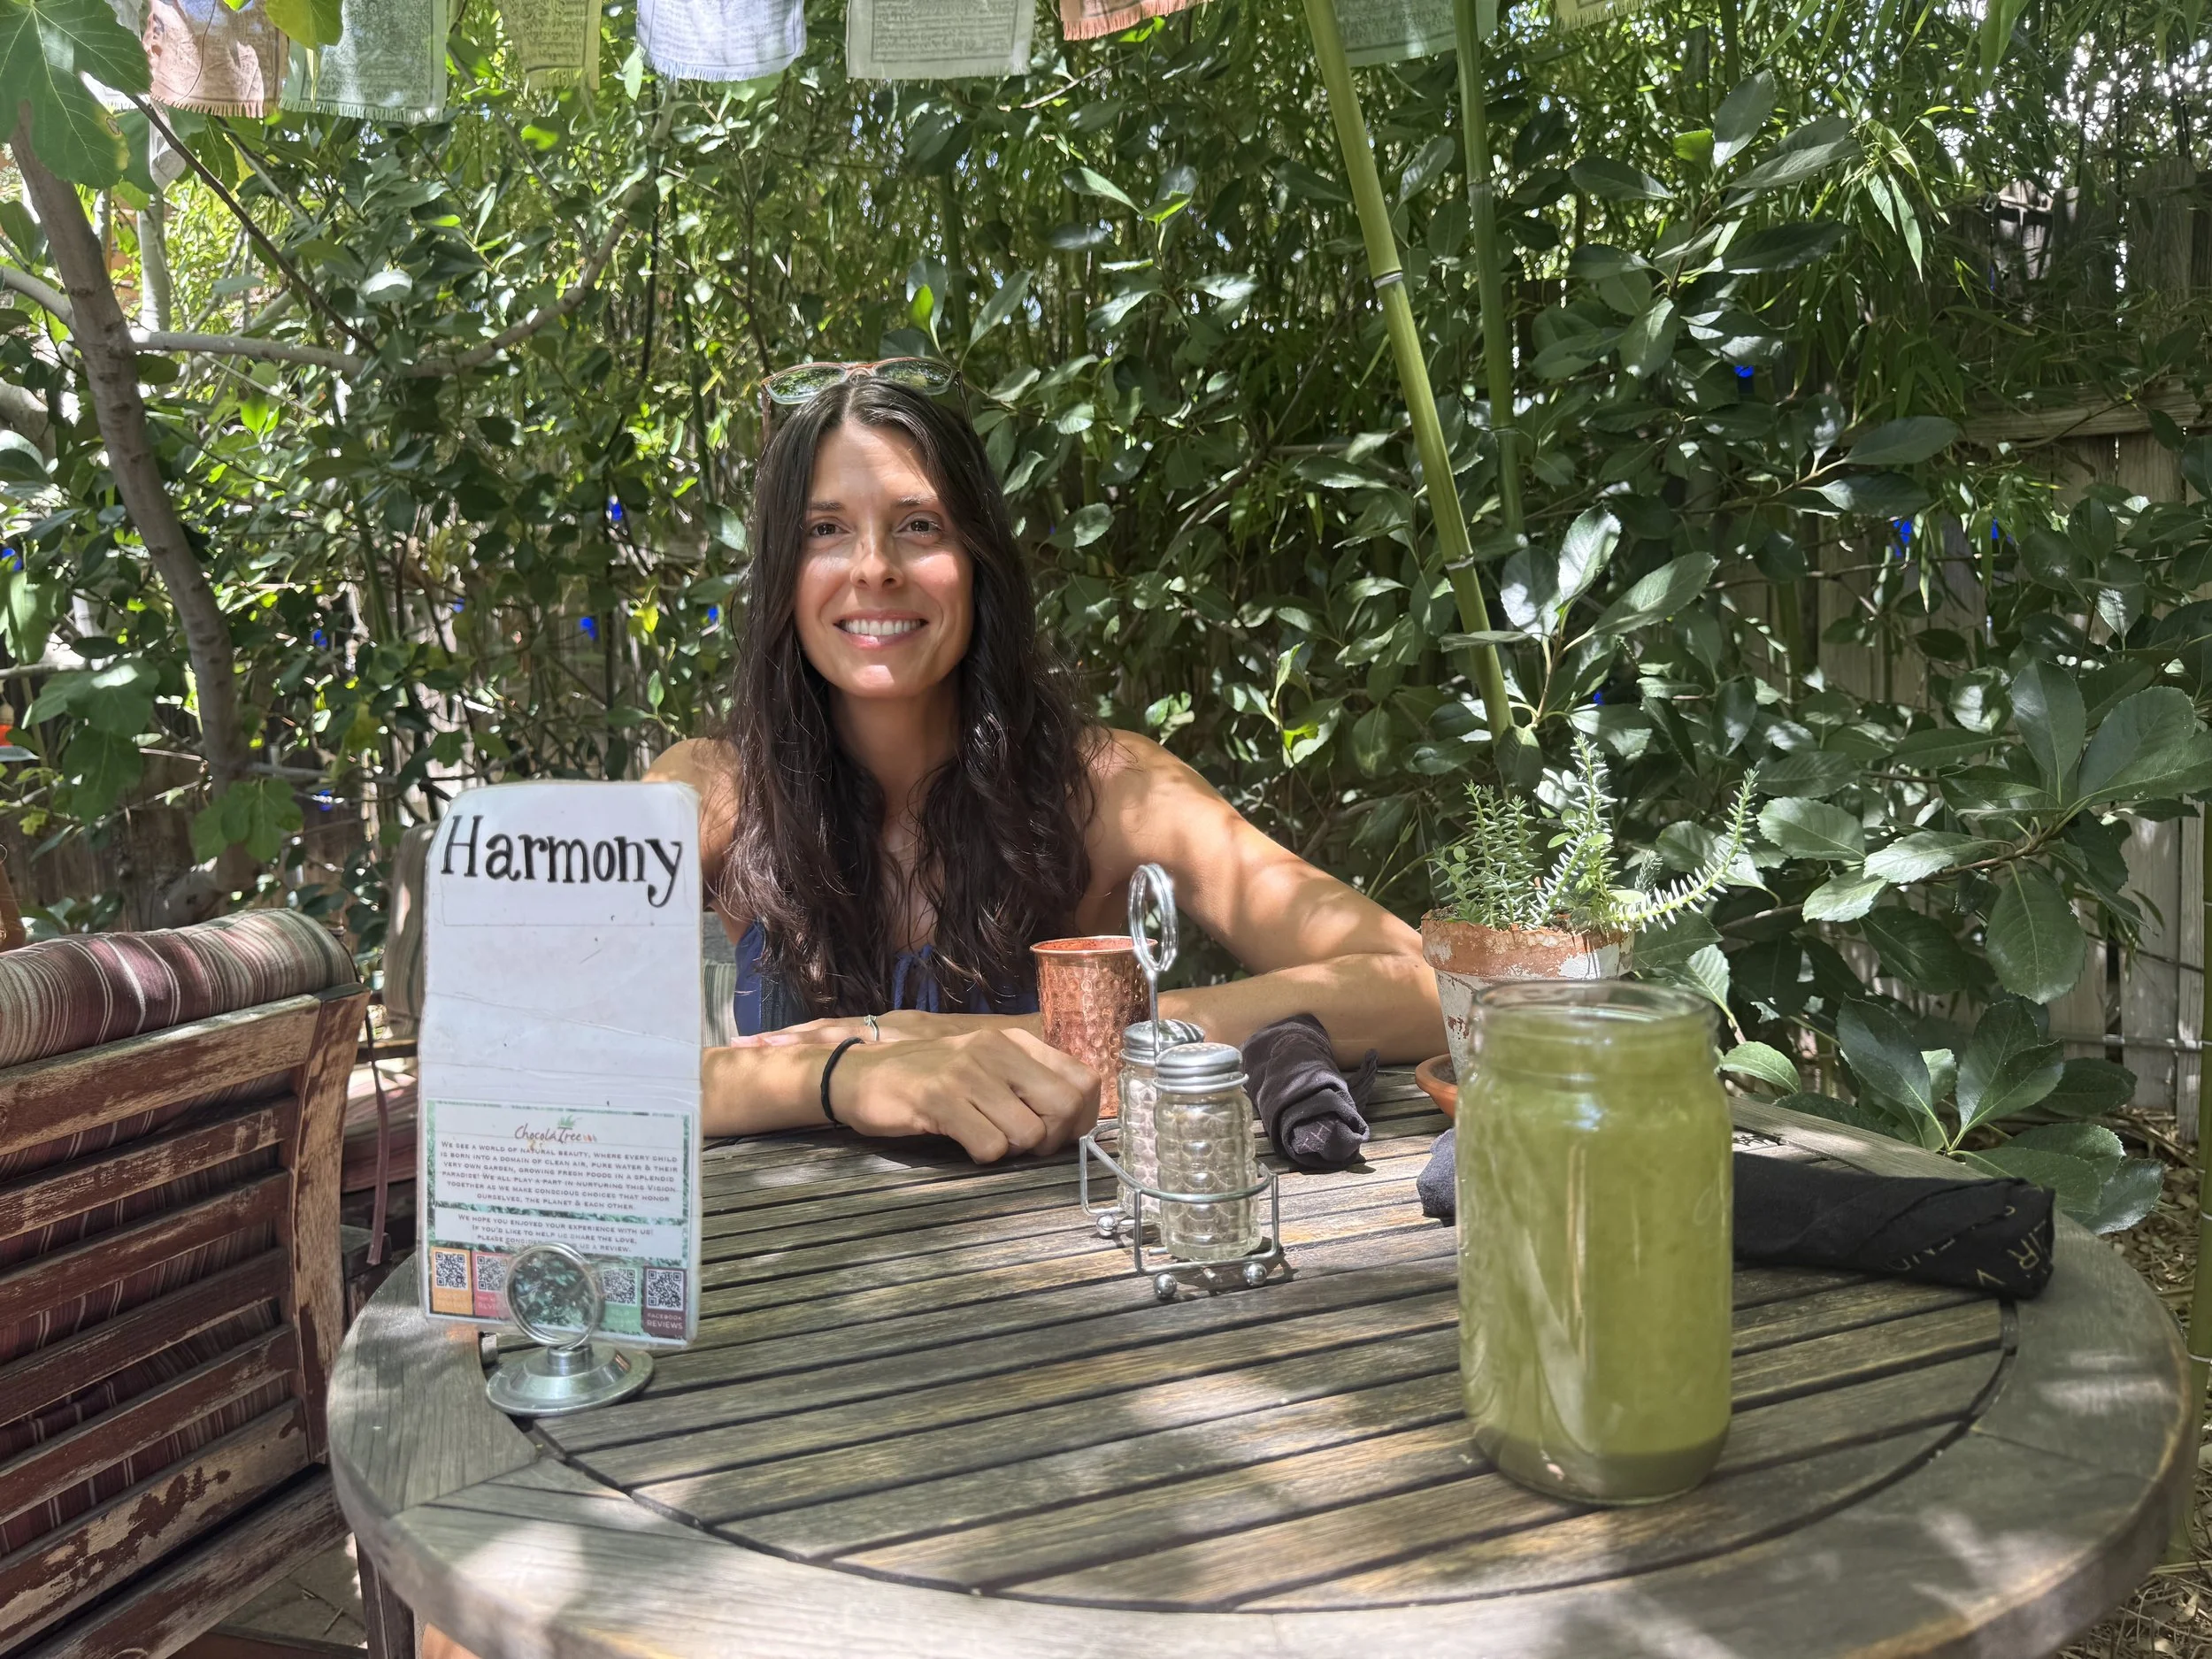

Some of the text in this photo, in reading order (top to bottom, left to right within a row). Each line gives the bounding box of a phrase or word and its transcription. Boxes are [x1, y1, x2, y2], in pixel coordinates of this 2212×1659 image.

[441, 815, 682, 908] Harmony
[483, 1164, 516, 1173] GARDEN,
[447, 1180, 485, 1189] TOGETHER
[534, 1187, 580, 1196] CONSCIOUS
[477, 1193, 523, 1202] OURSELVES,
[568, 1224, 615, 1233] EXPERIENCE
[647, 1320, 683, 1329] REVIEWS
